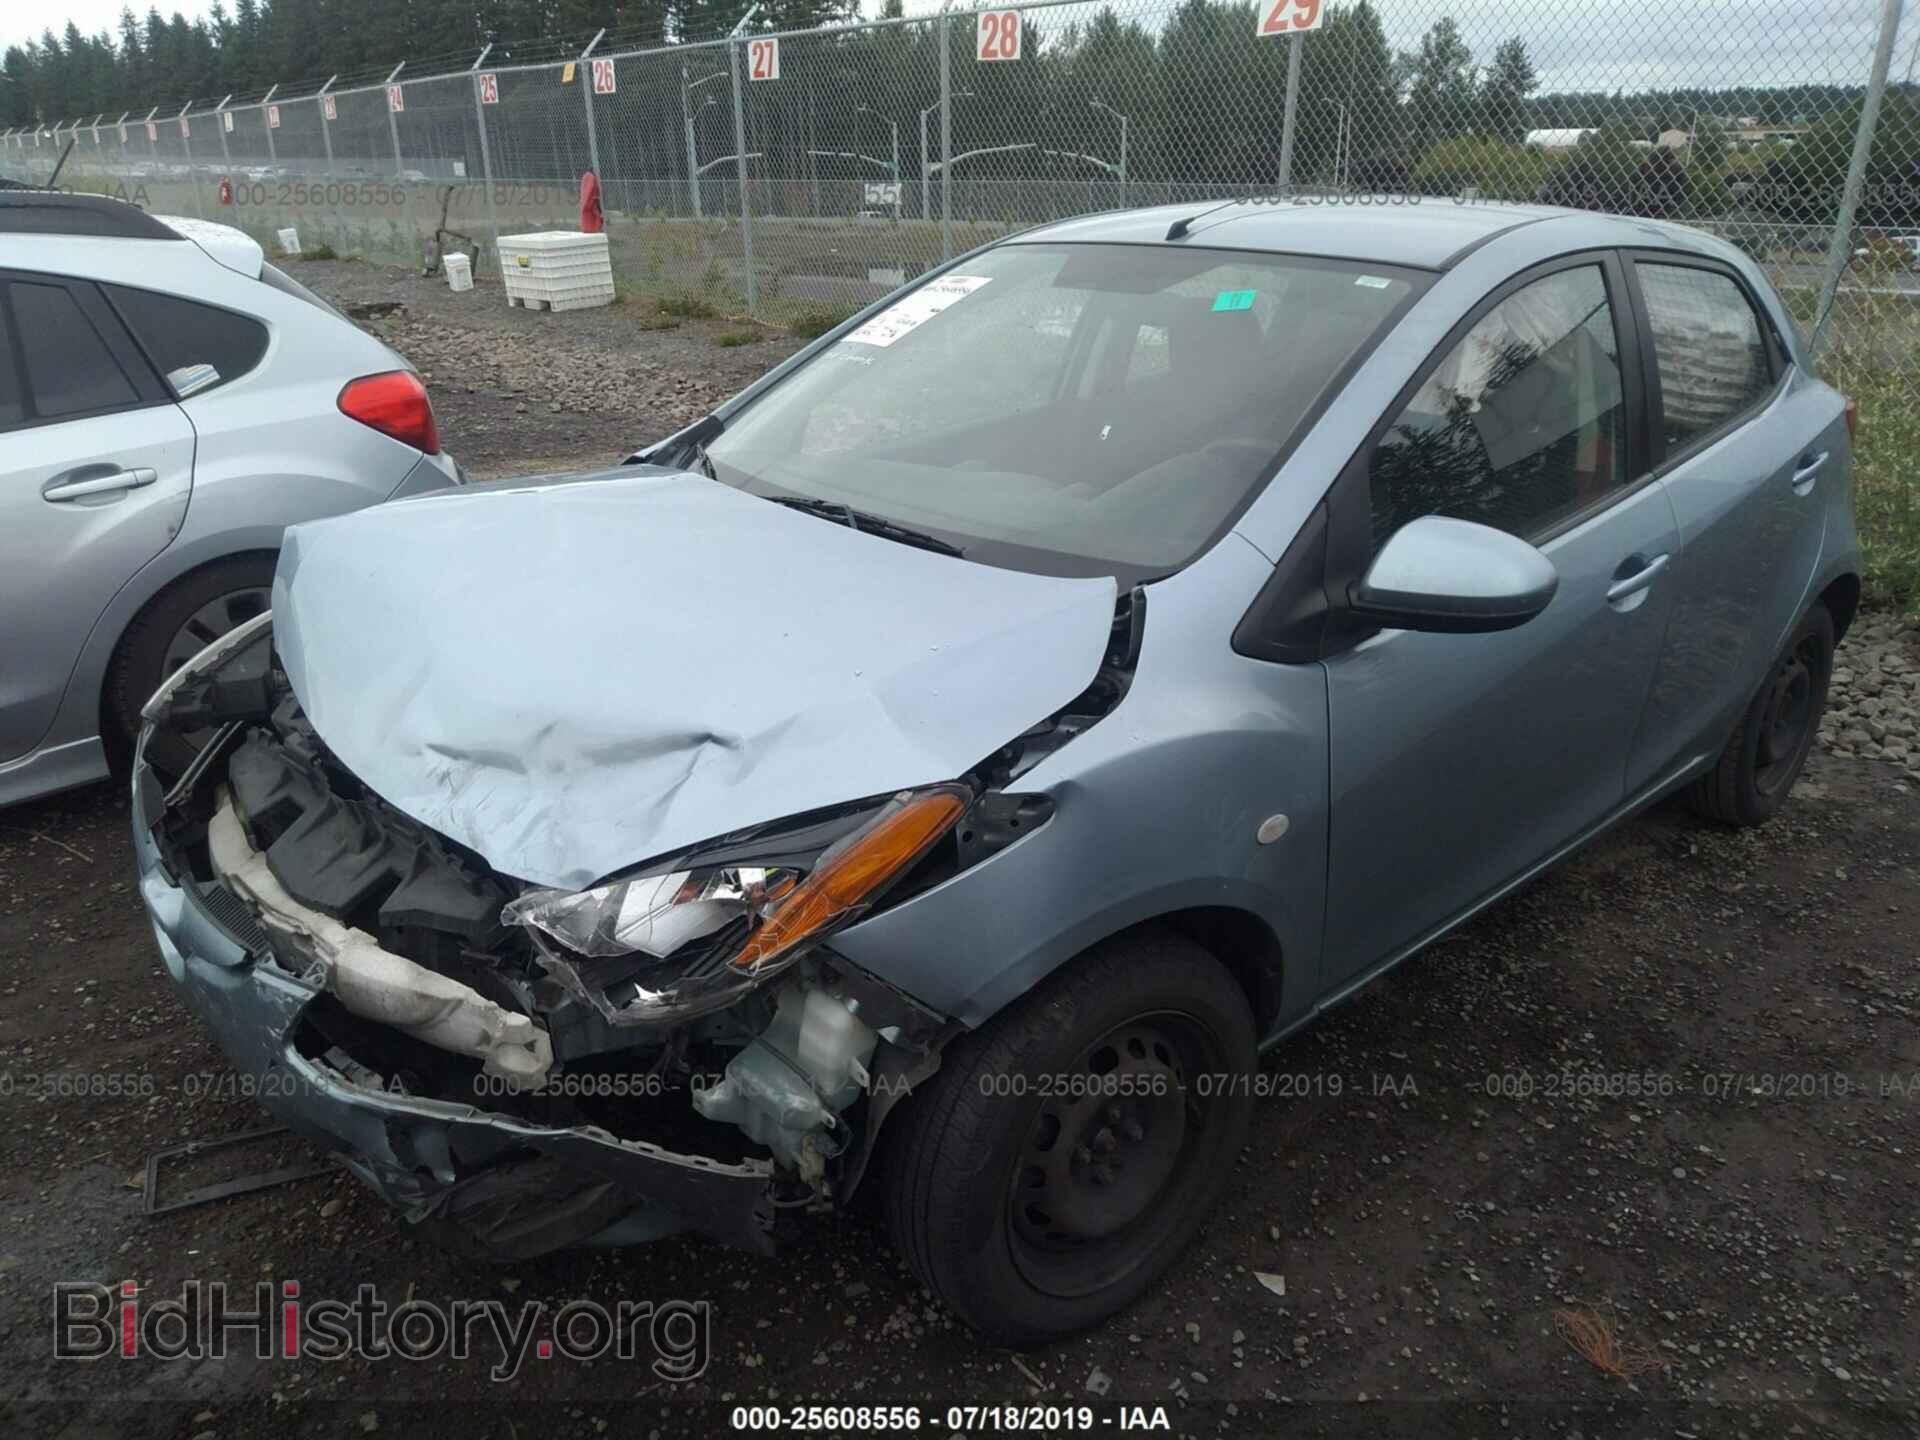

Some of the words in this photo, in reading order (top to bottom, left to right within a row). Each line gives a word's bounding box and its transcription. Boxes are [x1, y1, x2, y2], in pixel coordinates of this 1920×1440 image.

[1264, 0, 1321, 32] 29
[981, 12, 1018, 59] 28
[752, 42, 774, 78] 27
[481, 77, 497, 101] 25
[595, 63, 613, 92] 26
